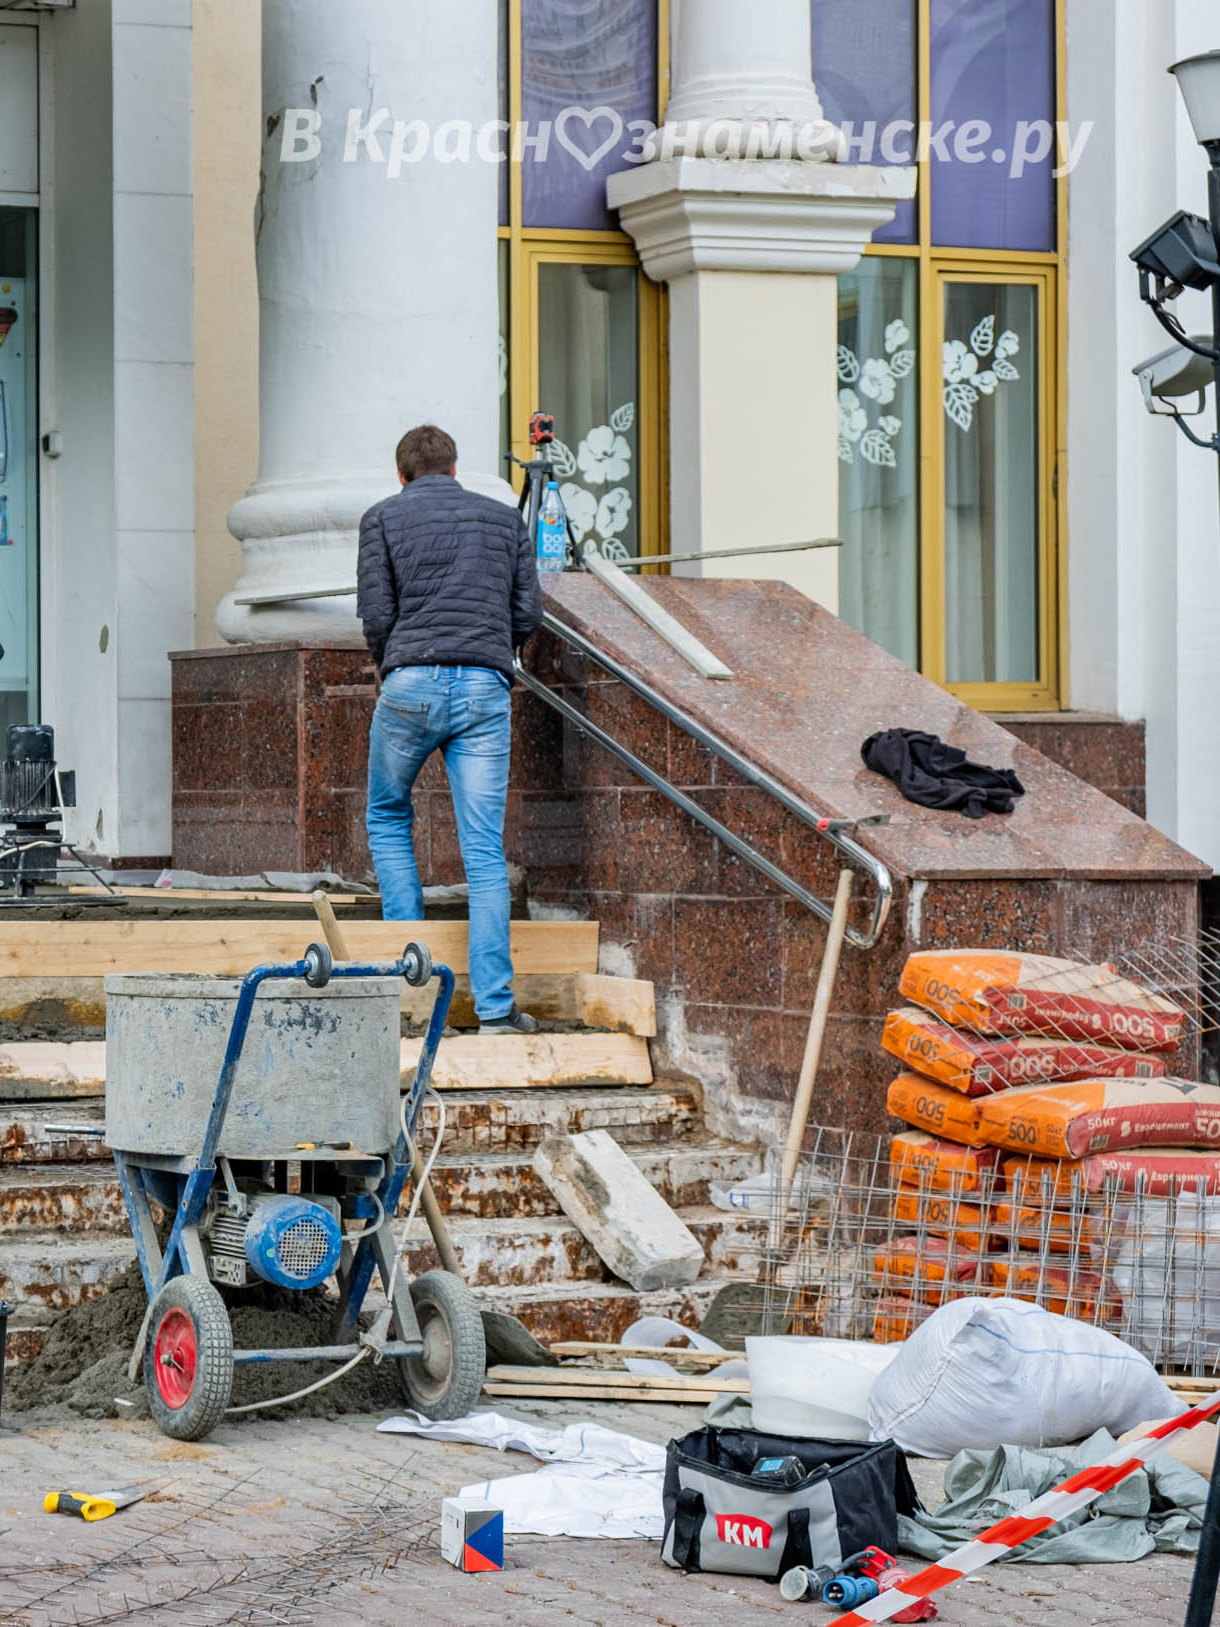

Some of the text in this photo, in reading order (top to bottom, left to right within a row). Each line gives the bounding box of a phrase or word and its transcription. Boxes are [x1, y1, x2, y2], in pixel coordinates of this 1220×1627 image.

[925, 978, 961, 1003] 500
[1112, 1011, 1156, 1038] 500
[908, 1033, 941, 1059] 500
[1009, 1053, 1055, 1076] 500
[915, 1095, 946, 1123] 500
[1008, 1120, 1039, 1145] 500
